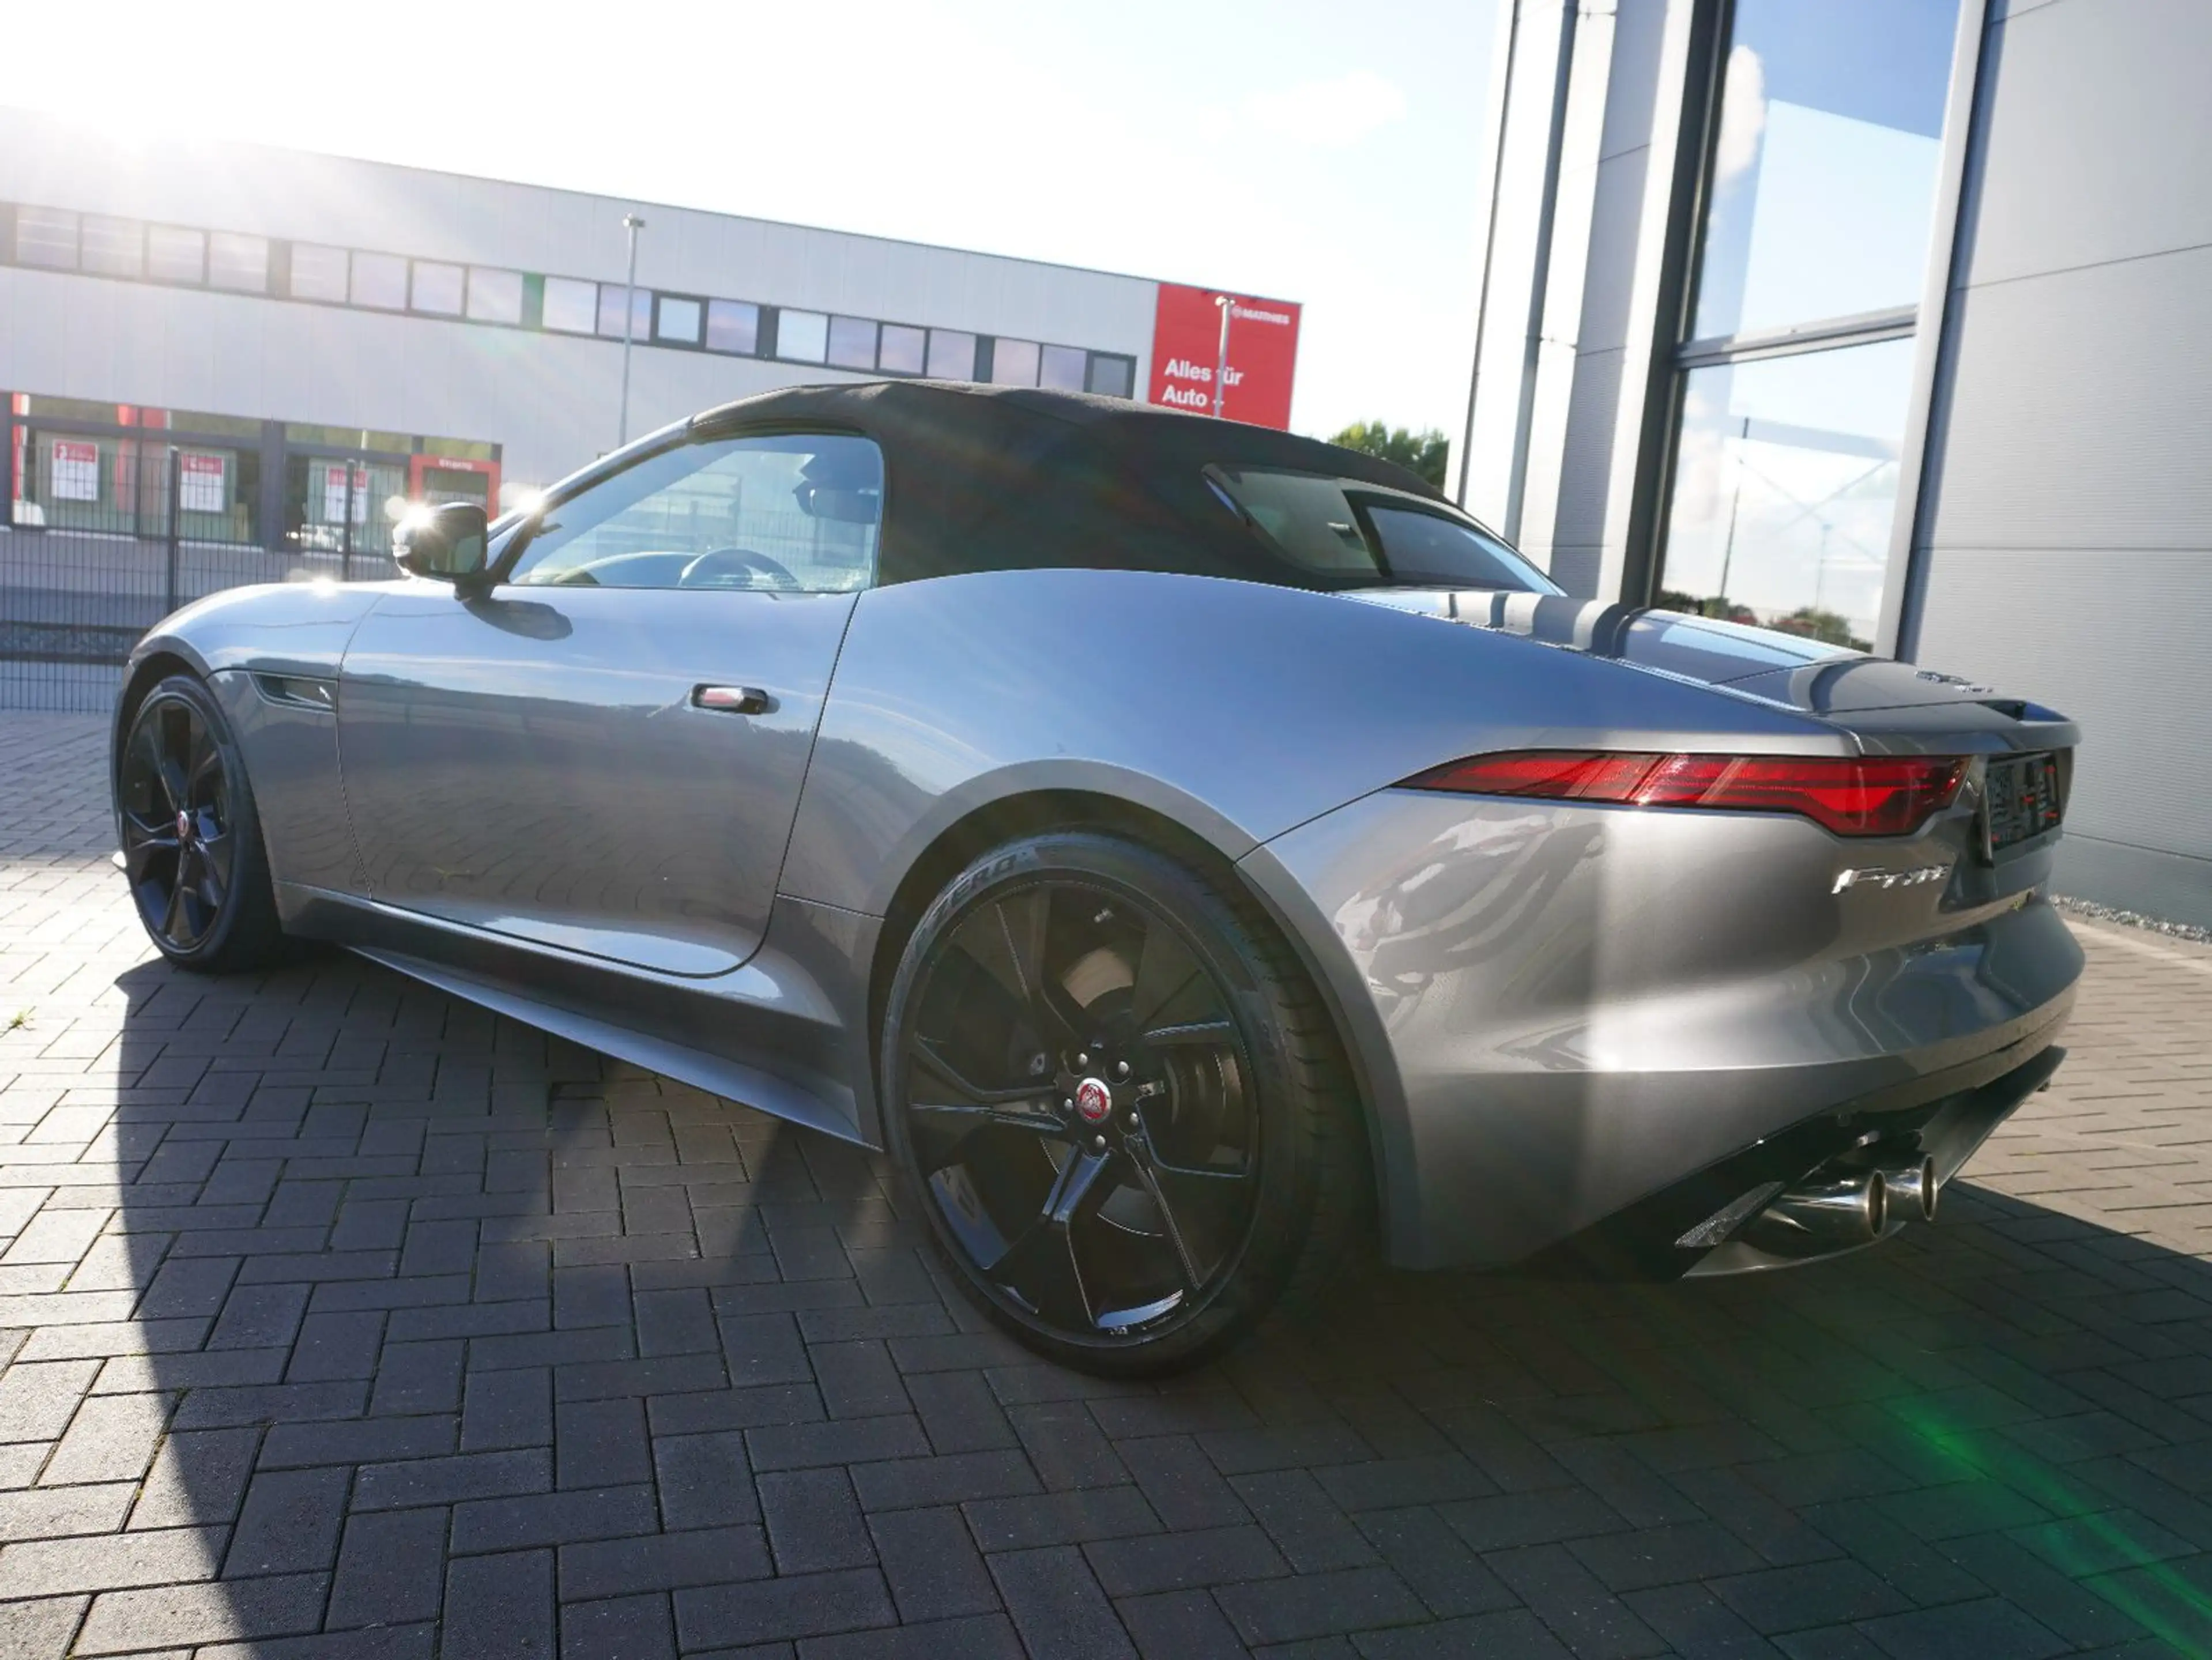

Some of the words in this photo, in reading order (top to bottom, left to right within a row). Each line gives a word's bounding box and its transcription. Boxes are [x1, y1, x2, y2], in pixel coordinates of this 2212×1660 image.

[1164, 358, 1212, 382] Alles
[1216, 365, 1244, 386] ür
[1162, 384, 1208, 407] Auto
